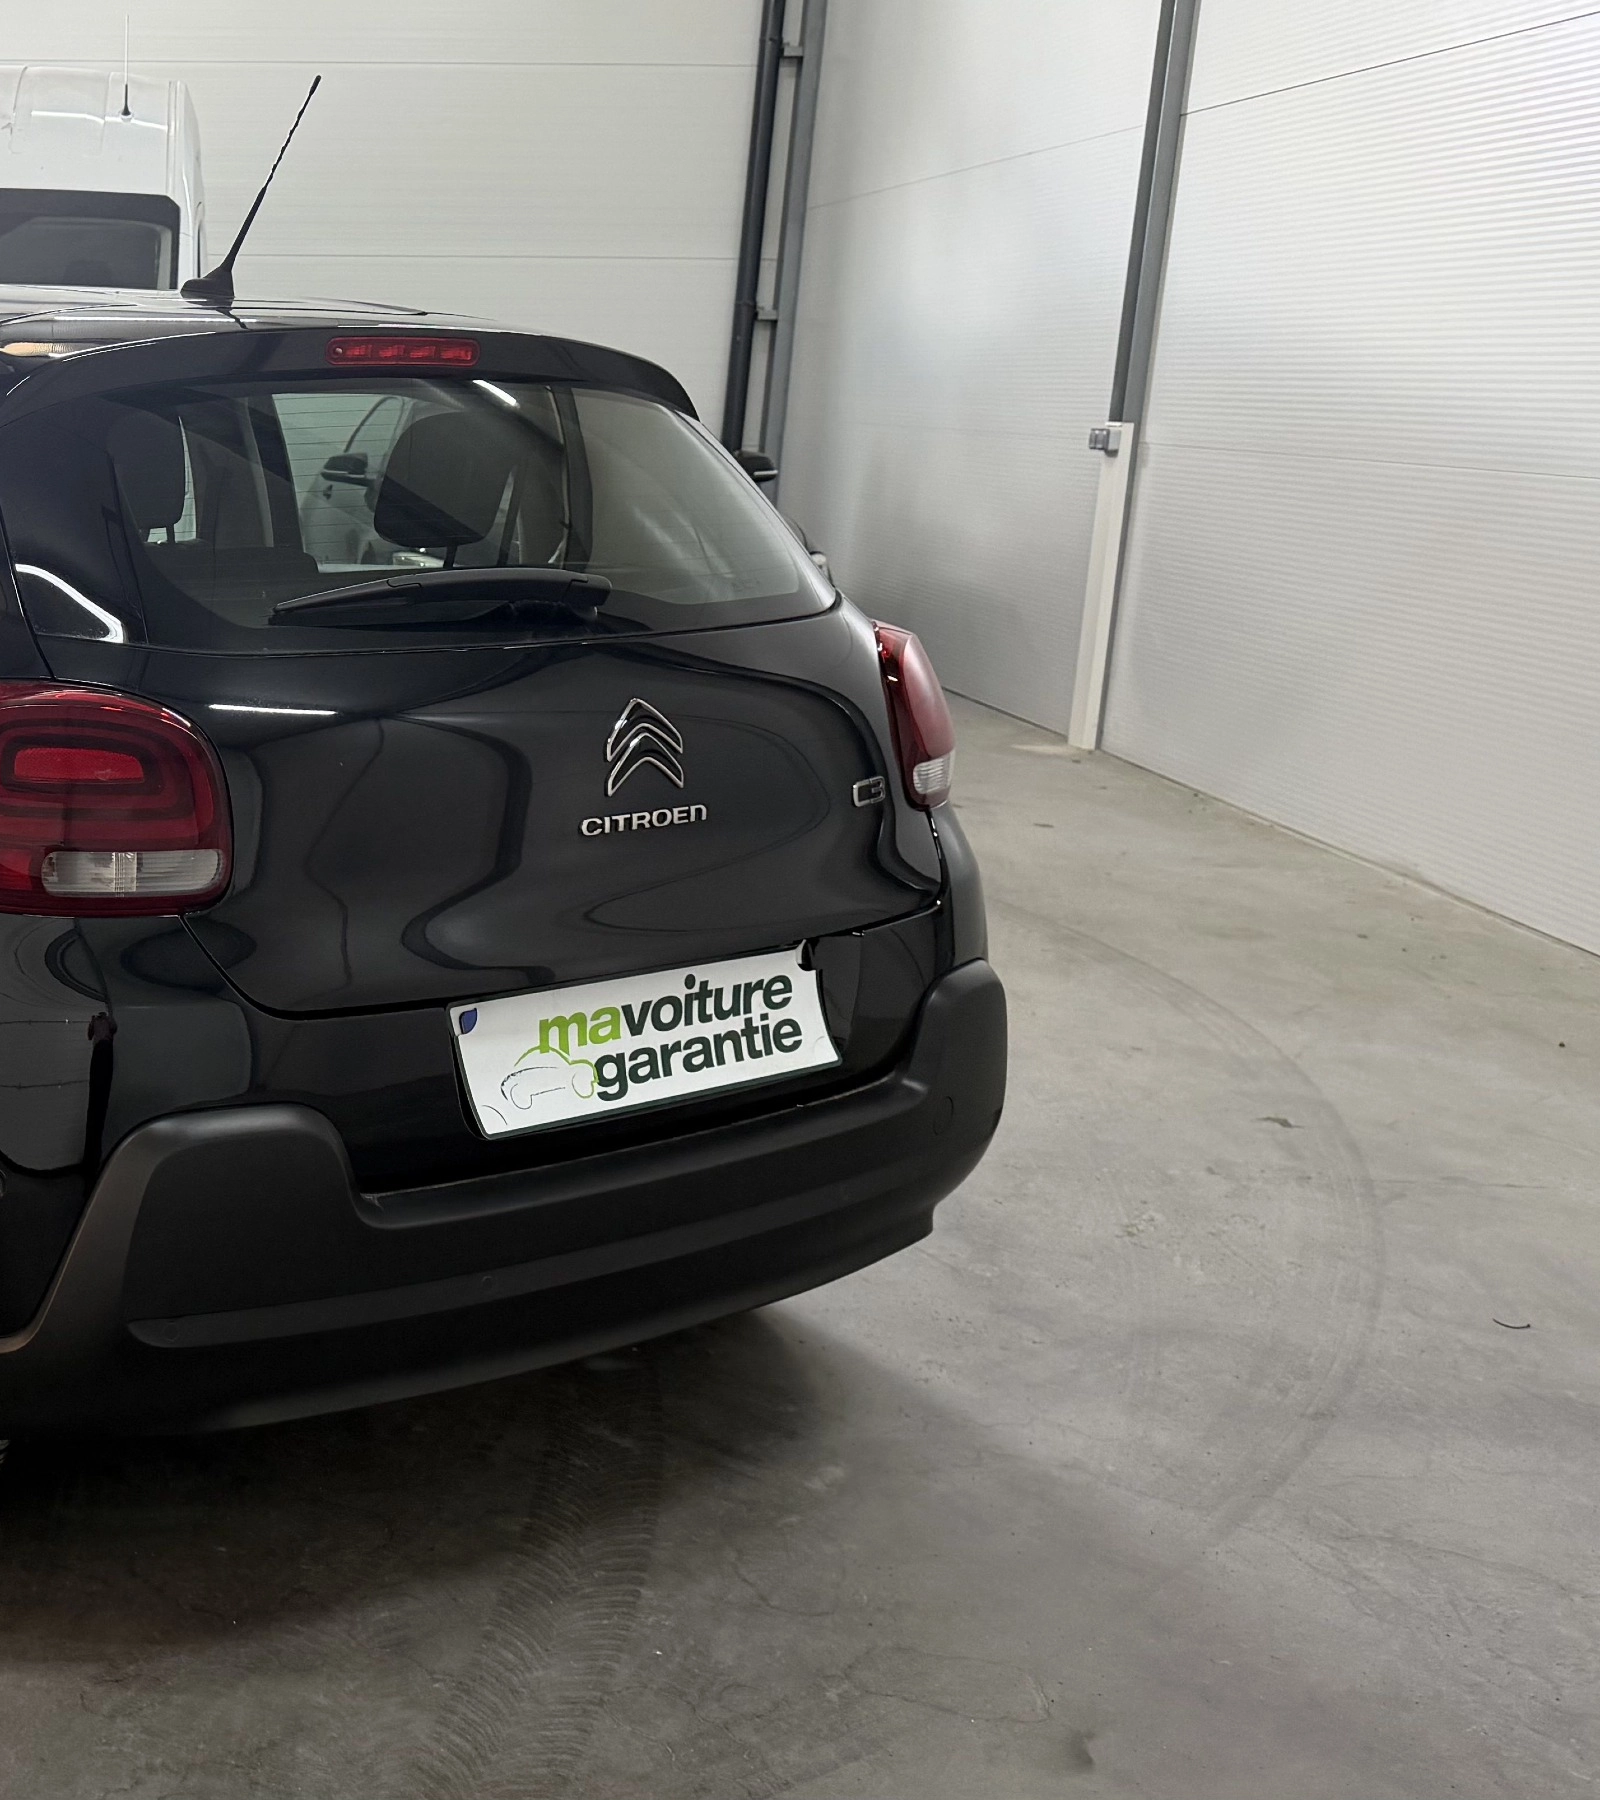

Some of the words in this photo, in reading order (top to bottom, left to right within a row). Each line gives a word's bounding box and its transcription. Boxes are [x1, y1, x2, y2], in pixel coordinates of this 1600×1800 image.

[852, 775, 885, 808] C3
[580, 803, 708, 837] CITROEN
[593, 1013, 804, 1102] garantie
